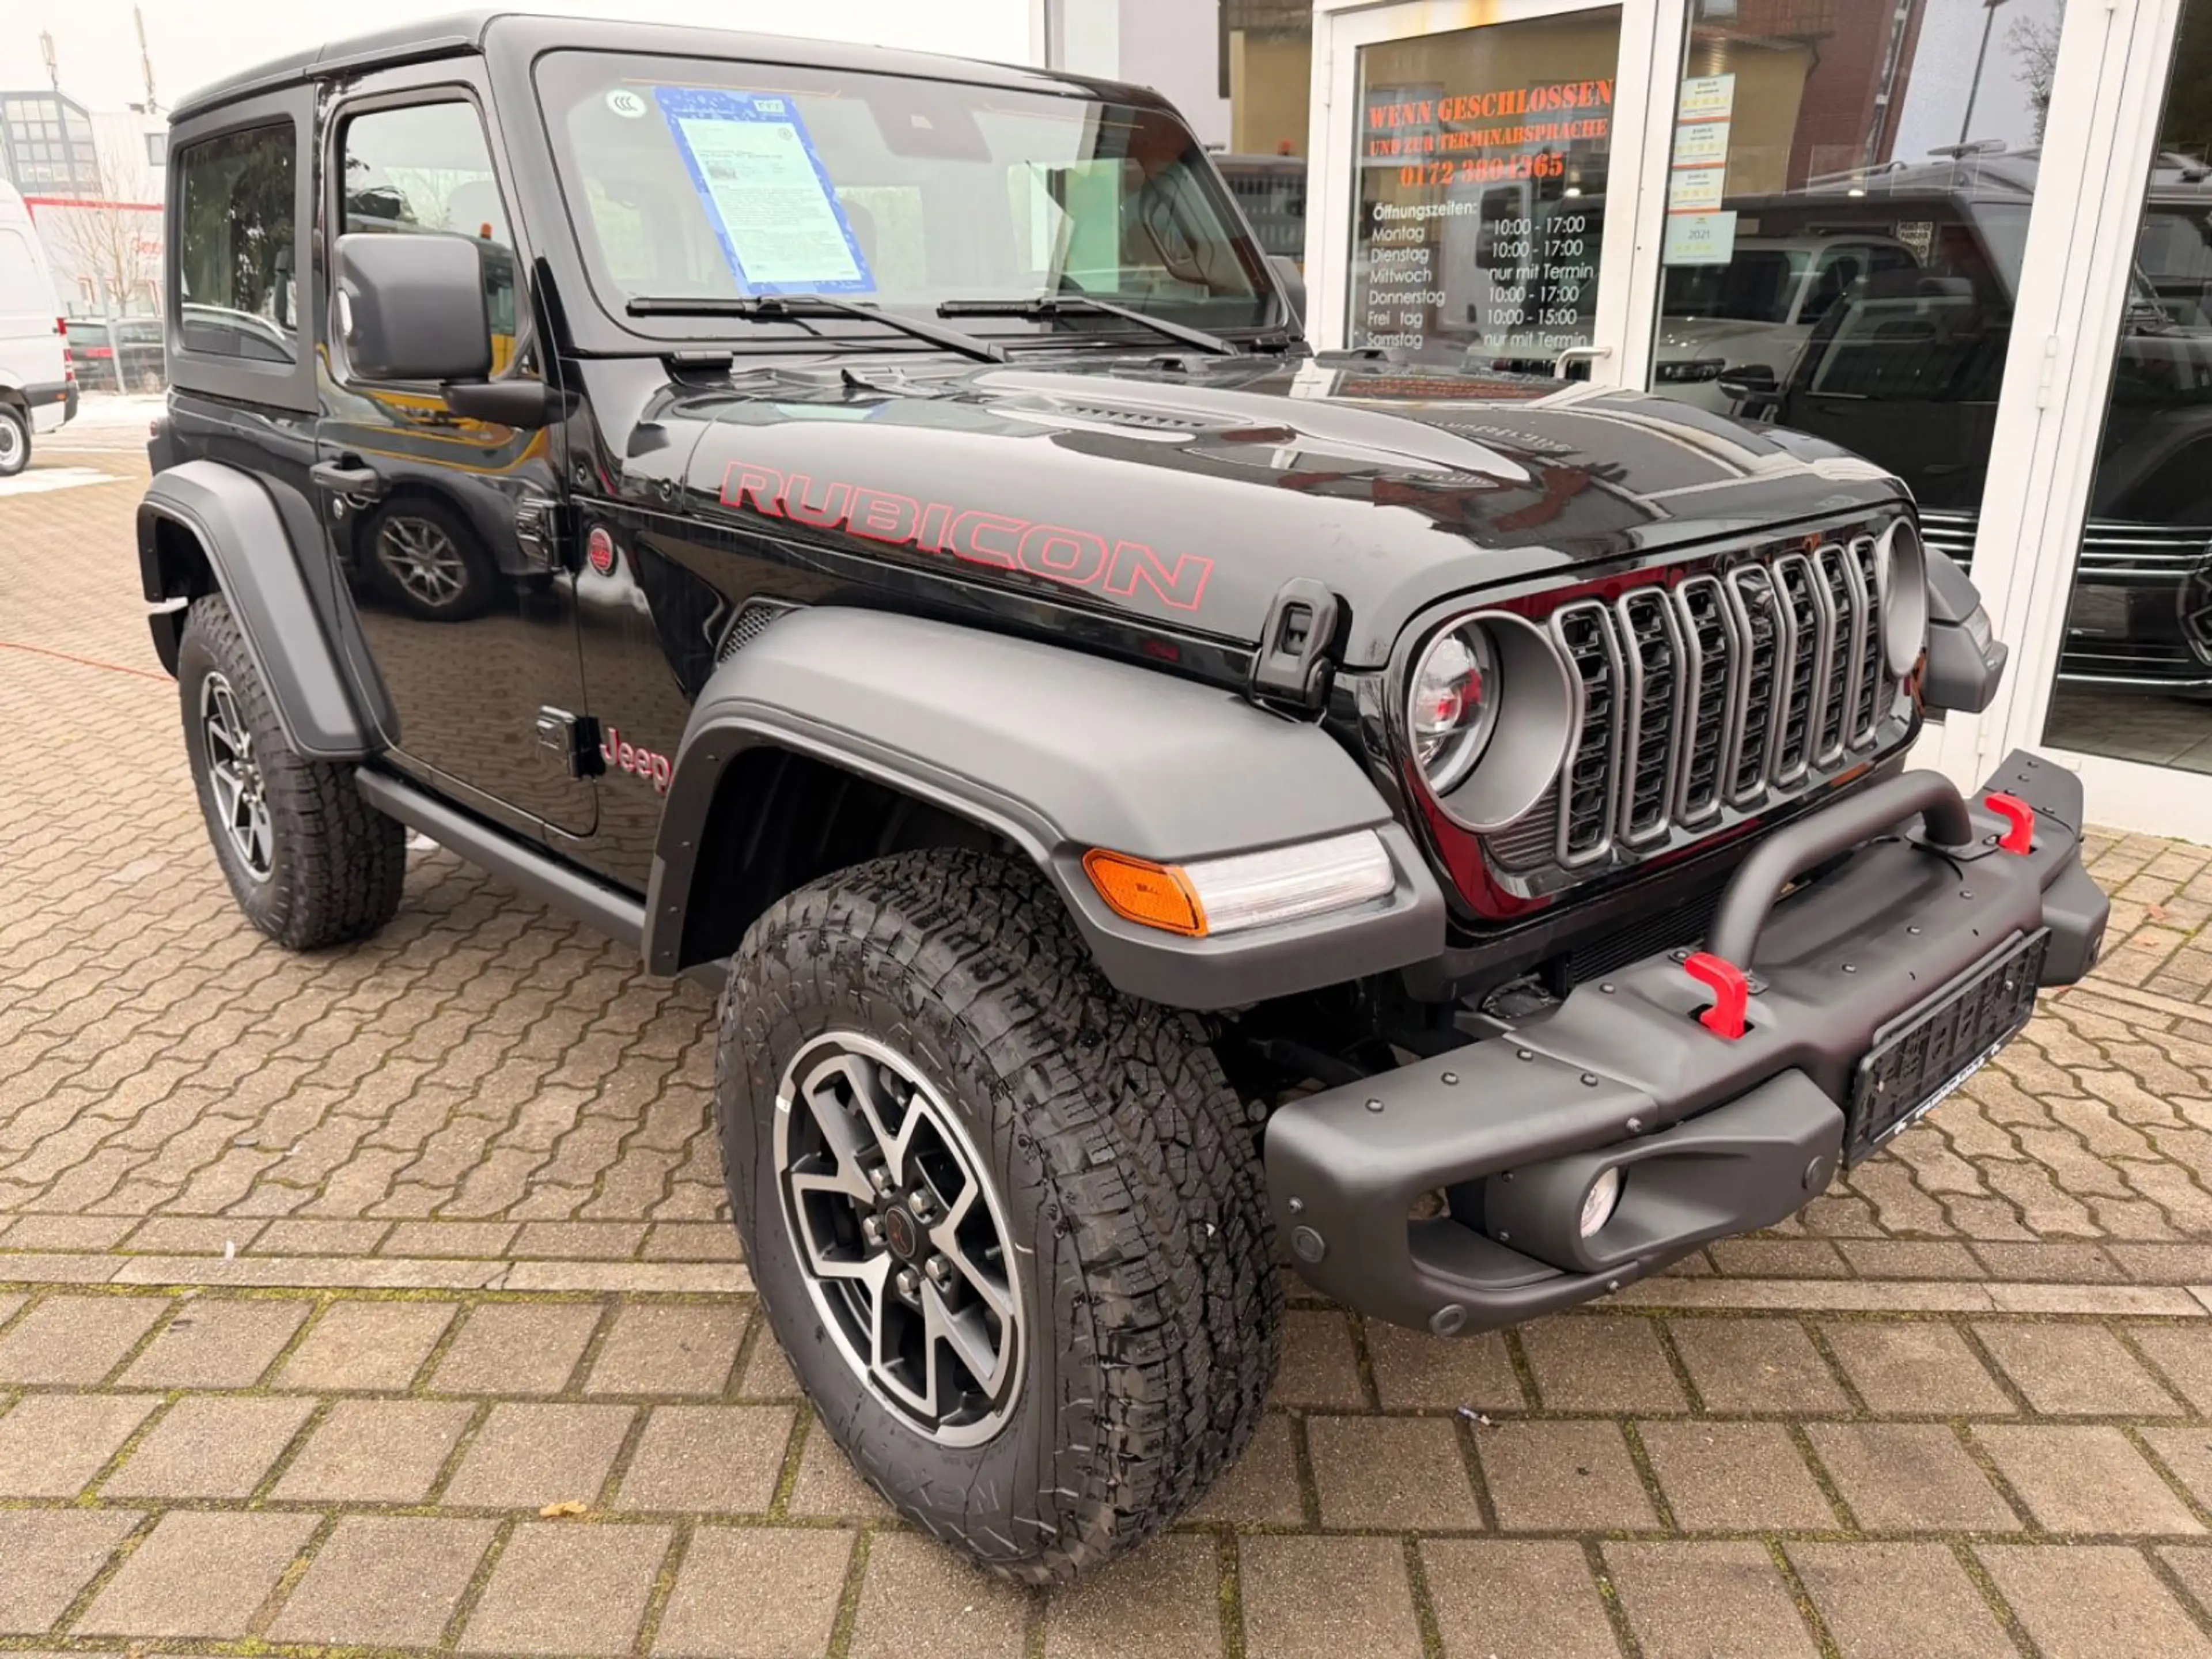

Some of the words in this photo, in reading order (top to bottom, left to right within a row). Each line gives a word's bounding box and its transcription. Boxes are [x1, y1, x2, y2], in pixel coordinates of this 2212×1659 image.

[1370, 100, 1433, 129] WENN
[1437, 79, 1614, 123] GESCHLOSSEN
[1370, 138, 1401, 157] UND
[1404, 134, 1433, 154] ZUR
[1439, 118, 1608, 153] TERMINABSPRACHE
[1400, 161, 1455, 188] 0172
[1373, 200, 1478, 221] Öffnungszeiten:
[1372, 226, 1425, 243] Montag
[1494, 218, 1532, 235] 10:00
[1546, 216, 1586, 233] 17:00
[1371, 247, 1430, 264] Dienstag
[1493, 241, 1530, 258] 10:00
[1544, 239, 1584, 257] 17:00
[1369, 267, 1432, 284] Mittwoch
[1488, 266, 1513, 281] nur
[1516, 263, 1540, 280] mit
[1543, 262, 1594, 279] Termin
[1368, 288, 1446, 307] Donnerstag
[1489, 286, 1526, 303] 10:00
[1540, 285, 1580, 302] 17:00
[1367, 310, 1391, 327] Frei
[1400, 311, 1423, 328] tag
[1487, 308, 1525, 325] 10:00
[1538, 308, 1578, 325] 15:00
[1366, 331, 1423, 350] Samstag
[1484, 334, 1507, 347] nur
[1510, 331, 1533, 346] mit
[1537, 331, 1588, 347] Termin
[720, 461, 1214, 611] RUBICON
[600, 727, 673, 794] Jeep
